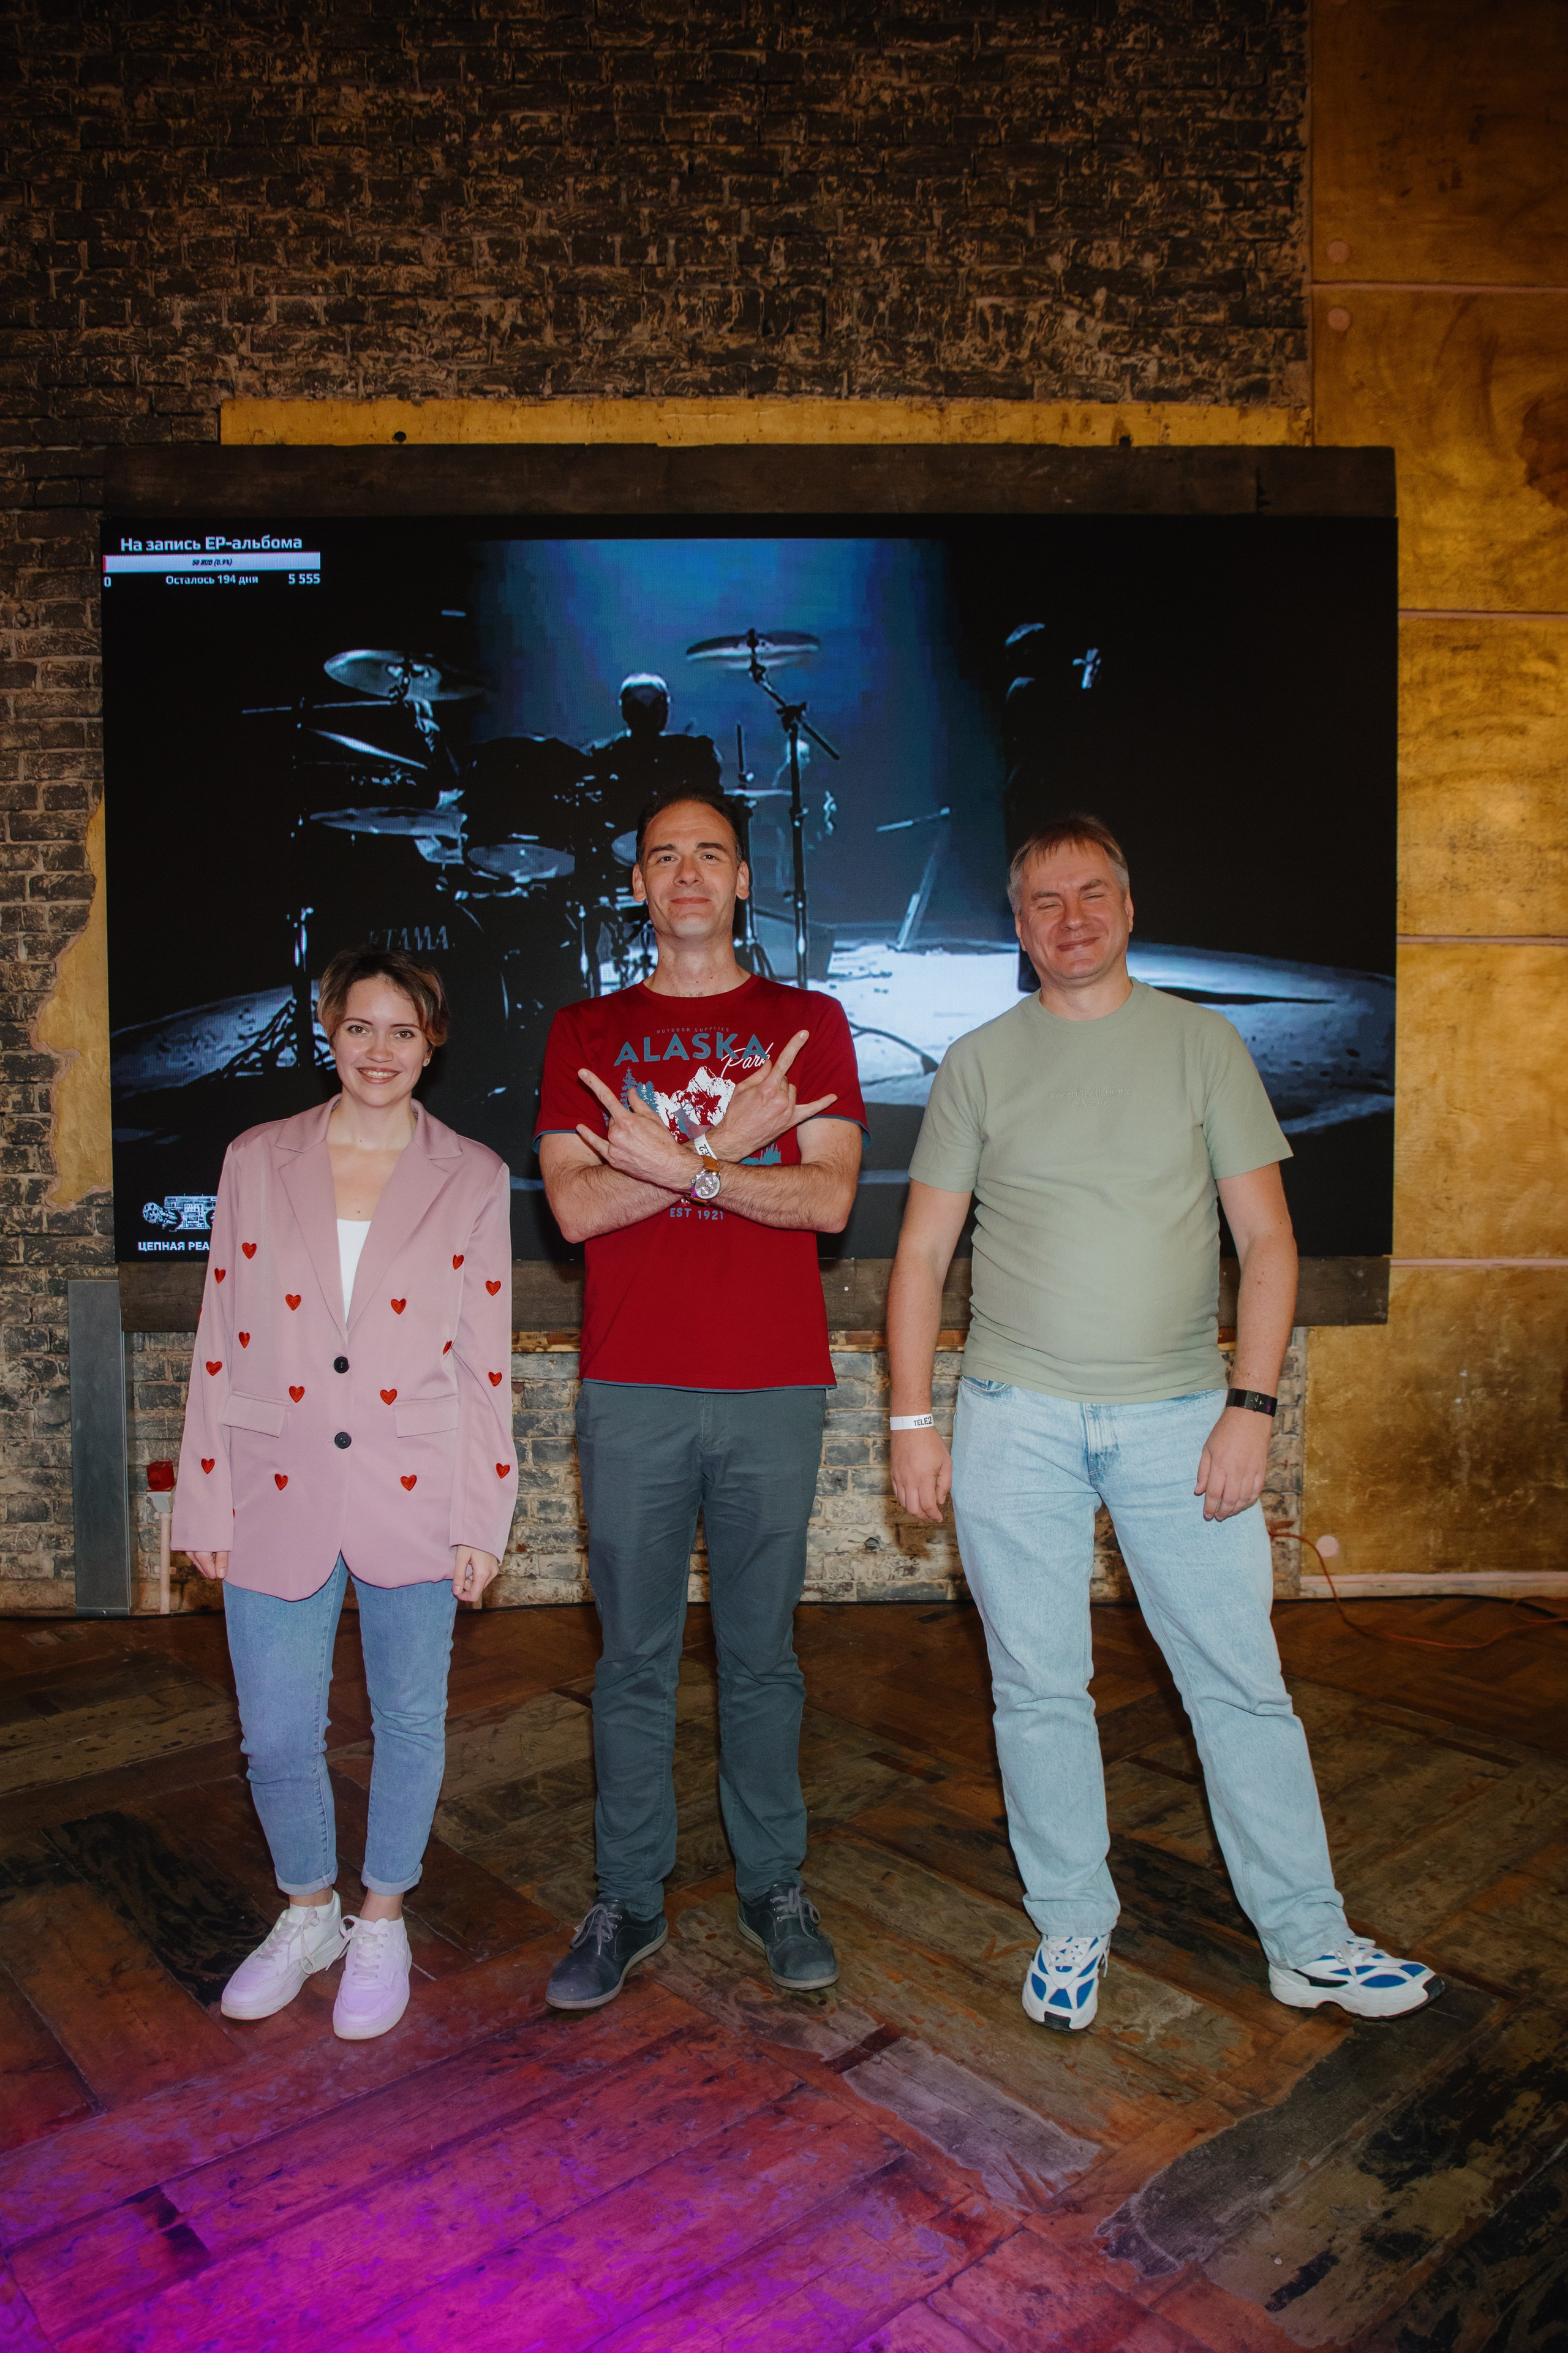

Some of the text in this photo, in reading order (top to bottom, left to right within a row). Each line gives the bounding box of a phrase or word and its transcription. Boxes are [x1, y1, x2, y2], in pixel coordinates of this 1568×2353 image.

[121, 538, 143, 551] На
[146, 539, 202, 551] запись
[103, 576, 111, 587] 0
[165, 574, 258, 585] Осталось 194 дня
[288, 573, 320, 584] 5 555
[614, 1032, 768, 1067] ALASKA
[670, 1207, 723, 1220] EST 1921
[138, 1241, 186, 1252] ЦЕПНАЯ
[913, 1416, 932, 1426] TELE2
